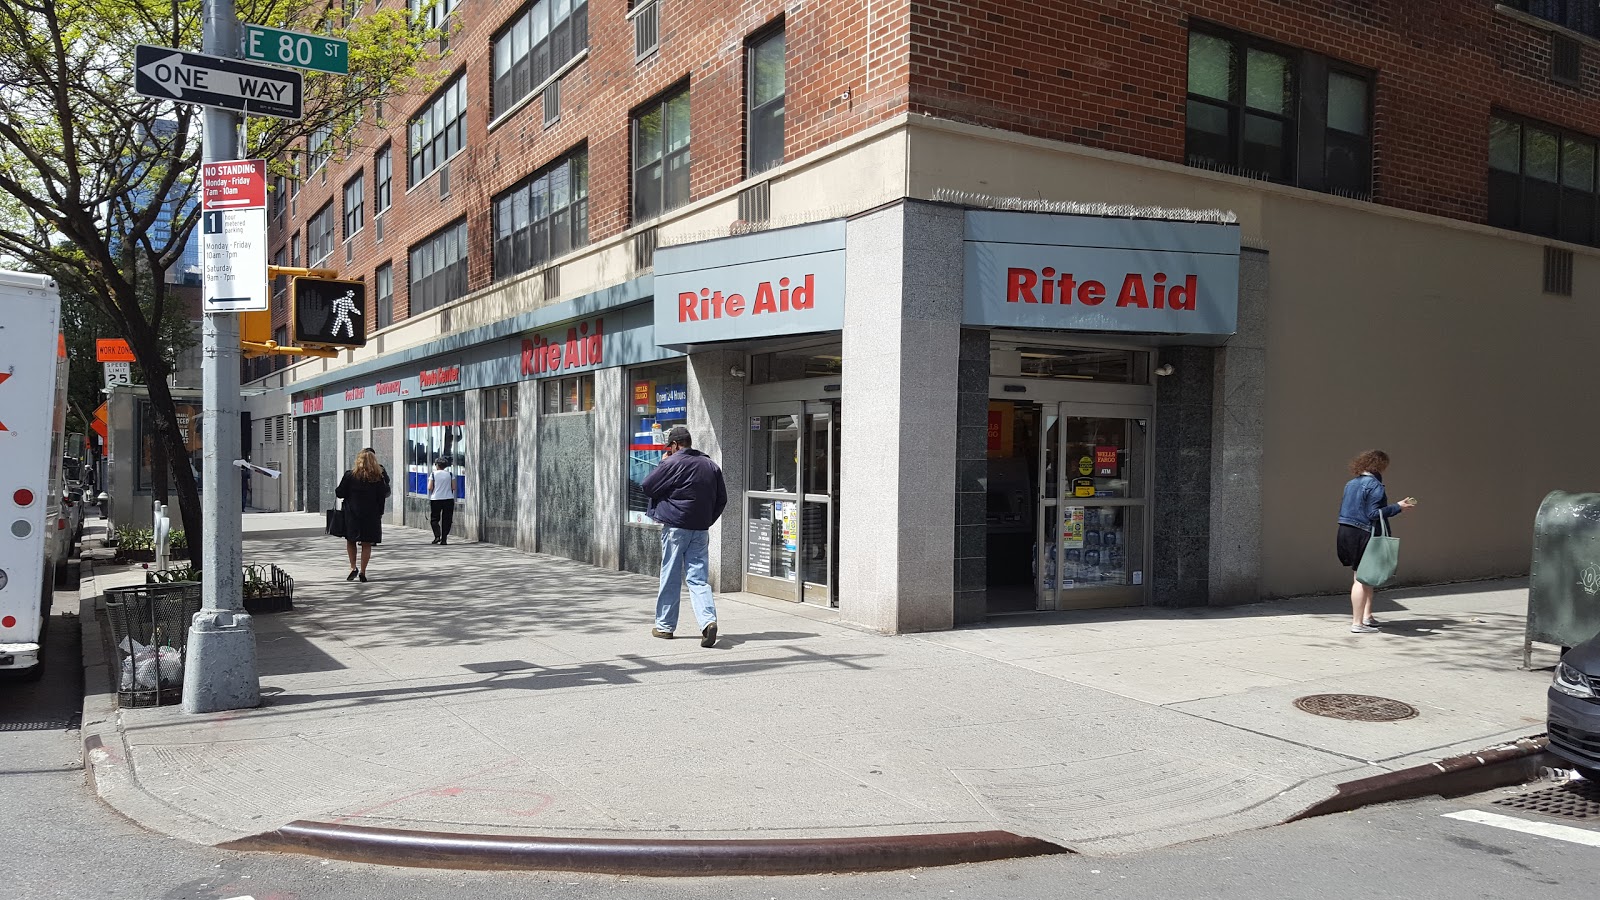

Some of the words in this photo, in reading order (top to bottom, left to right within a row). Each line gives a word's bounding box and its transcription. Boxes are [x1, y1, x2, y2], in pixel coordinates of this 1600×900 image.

[249, 30, 265, 58] E
[278, 34, 313, 66] 80
[324, 42, 340, 59] ST
[154, 62, 209, 90] ONE
[238, 76, 288, 103] WAY
[205, 166, 217, 178] NO
[217, 163, 256, 176] STANDING
[205, 178, 228, 188] Monday
[232, 177, 251, 186] Friday
[206, 188, 218, 196] 7am
[222, 186, 239, 195] 10am
[209, 212, 216, 233] 1
[224, 213, 236, 221] hour
[224, 226, 244, 235] parking
[206, 242, 229, 251] Monday
[233, 240, 252, 250] Friday
[206, 251, 221, 260] 10am
[226, 250, 238, 260] 7pm
[206, 264, 233, 273] Saturday
[206, 274, 219, 282] 9am
[224, 274, 236, 283] 7pm
[1006, 266, 1107, 306] Rite
[1115, 272, 1198, 311] Aid
[678, 287, 747, 323] Rite
[752, 273, 815, 315] Aid
[100, 346, 116, 355] WORK
[521, 333, 561, 377] Rite
[564, 318, 604, 370] Aid
[108, 374, 128, 383] 25
[419, 369, 437, 387] Photo
[438, 365, 459, 383] Center
[375, 381, 401, 396] Pharmacy
[656, 392, 666, 403] Open
[667, 390, 673, 401] 24
[674, 390, 686, 400] Hours
